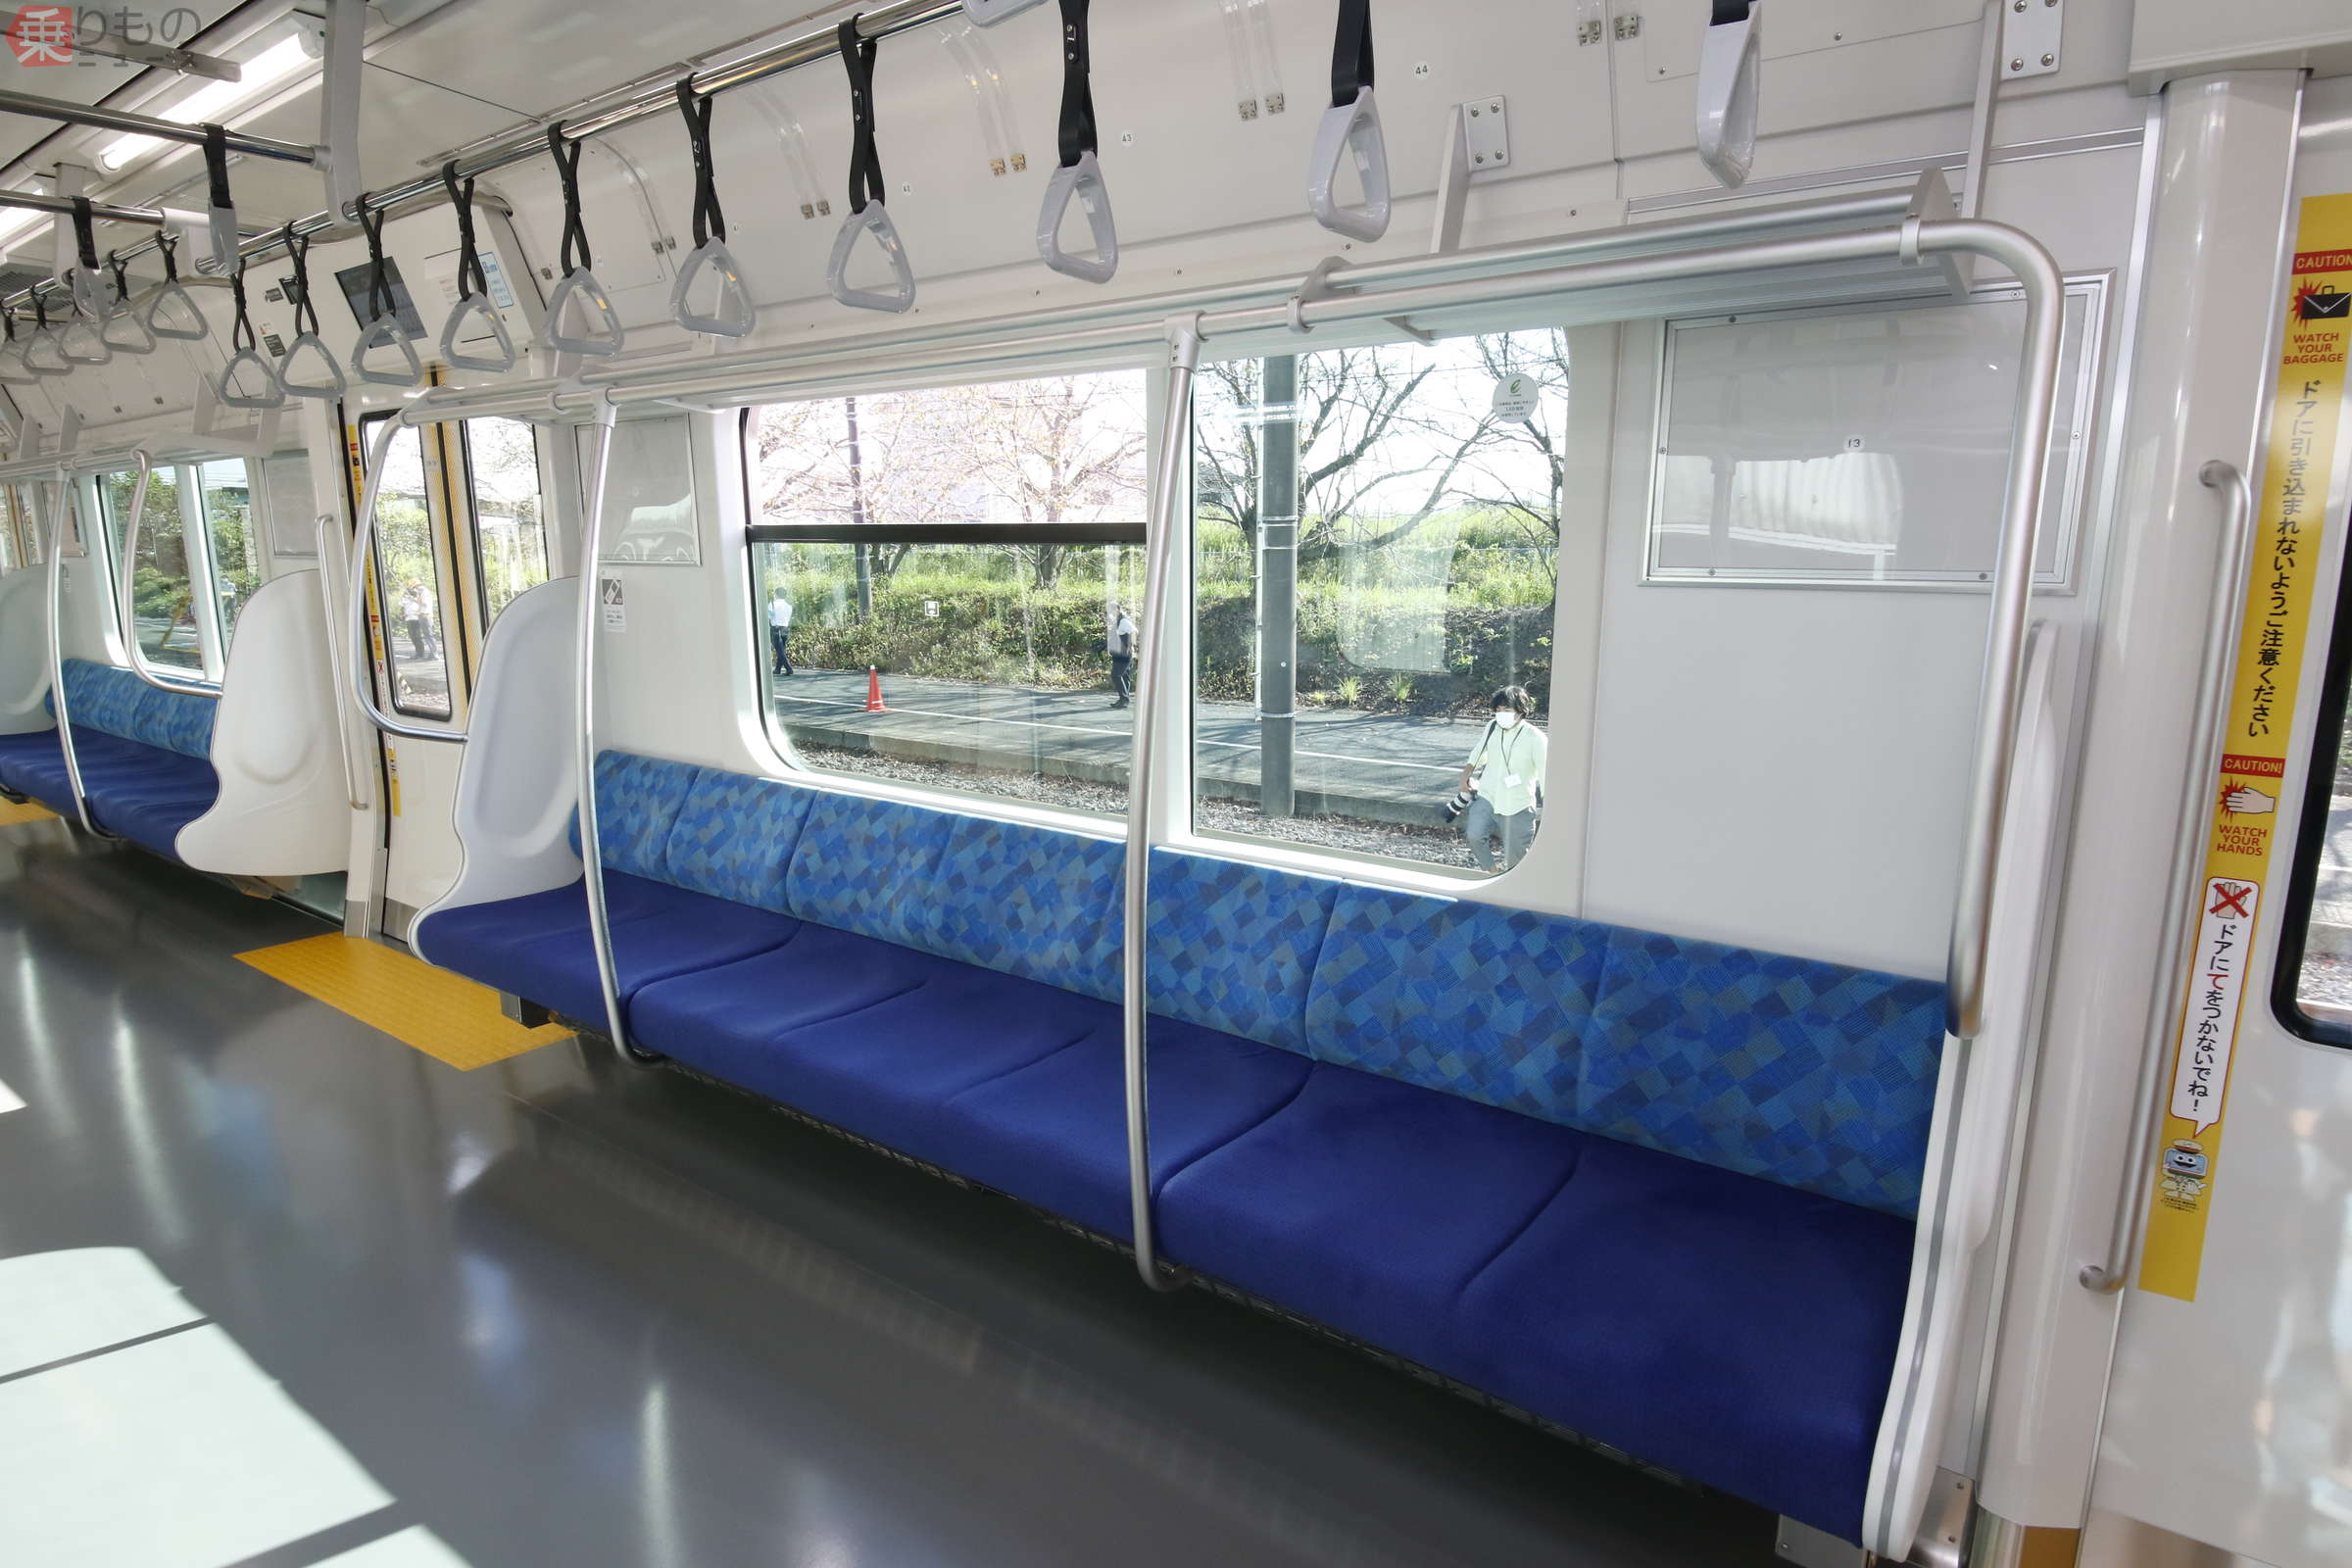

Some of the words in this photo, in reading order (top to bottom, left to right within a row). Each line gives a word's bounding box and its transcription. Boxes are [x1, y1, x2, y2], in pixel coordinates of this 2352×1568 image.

[1415, 65, 1428, 74] 44
[2293, 332, 2339, 344] WATCH
[2297, 343, 2332, 354] YOUR
[2282, 353, 2344, 365] BAGGAGE
[1848, 438, 1860, 448] 13
[2248, 379, 2322, 737] ドアに引き込まれないようご注意ください
[2224, 759, 2283, 774] CAUTION!
[2219, 824, 2267, 838] WATCH
[2223, 834, 2260, 847] YOUR
[2216, 843, 2264, 857] HANDS
